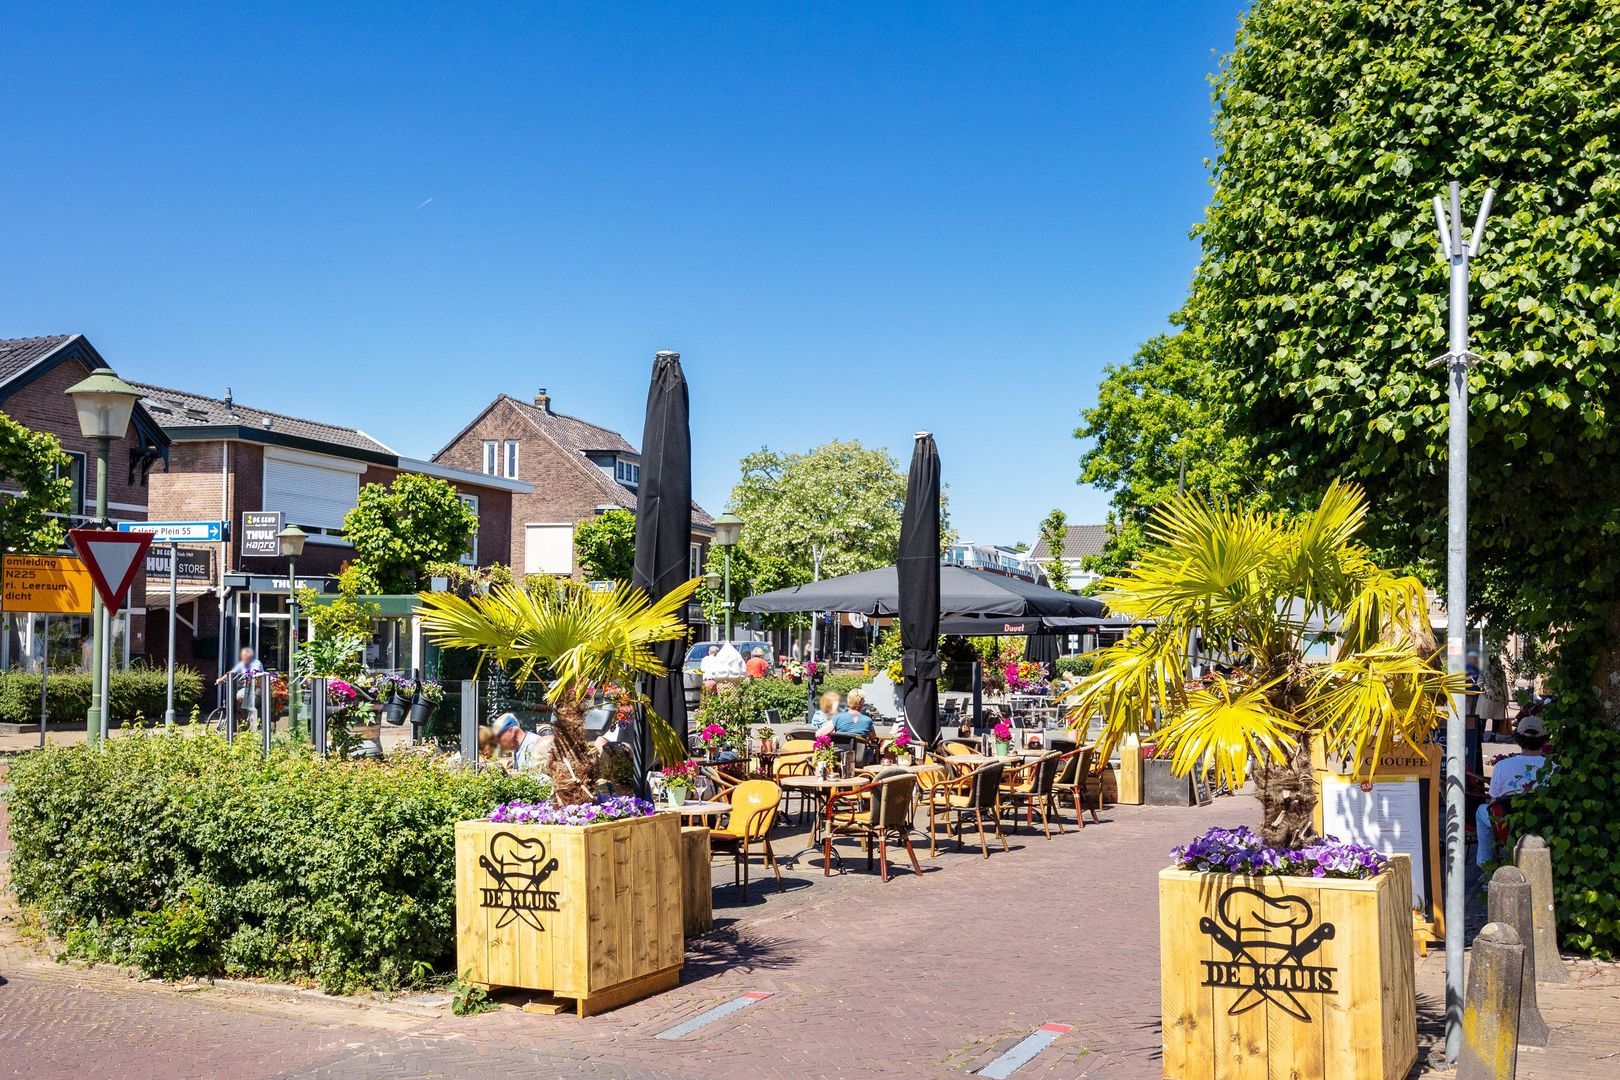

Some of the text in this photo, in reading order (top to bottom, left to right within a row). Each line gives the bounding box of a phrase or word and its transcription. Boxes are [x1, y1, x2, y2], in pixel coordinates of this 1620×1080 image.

[161, 527, 180, 535] Plein
[182, 527, 191, 535] 55
[246, 530, 274, 540] THULE
[6, 558, 57, 568] omleiding
[178, 563, 205, 574] STORE
[6, 570, 36, 579] N225
[22, 582, 68, 591] Leersum
[5, 592, 33, 600] dicht
[1004, 624, 1025, 632] Duvel
[482, 889, 557, 910] DE KLUIS
[1205, 962, 1334, 991] DE KLUIS
